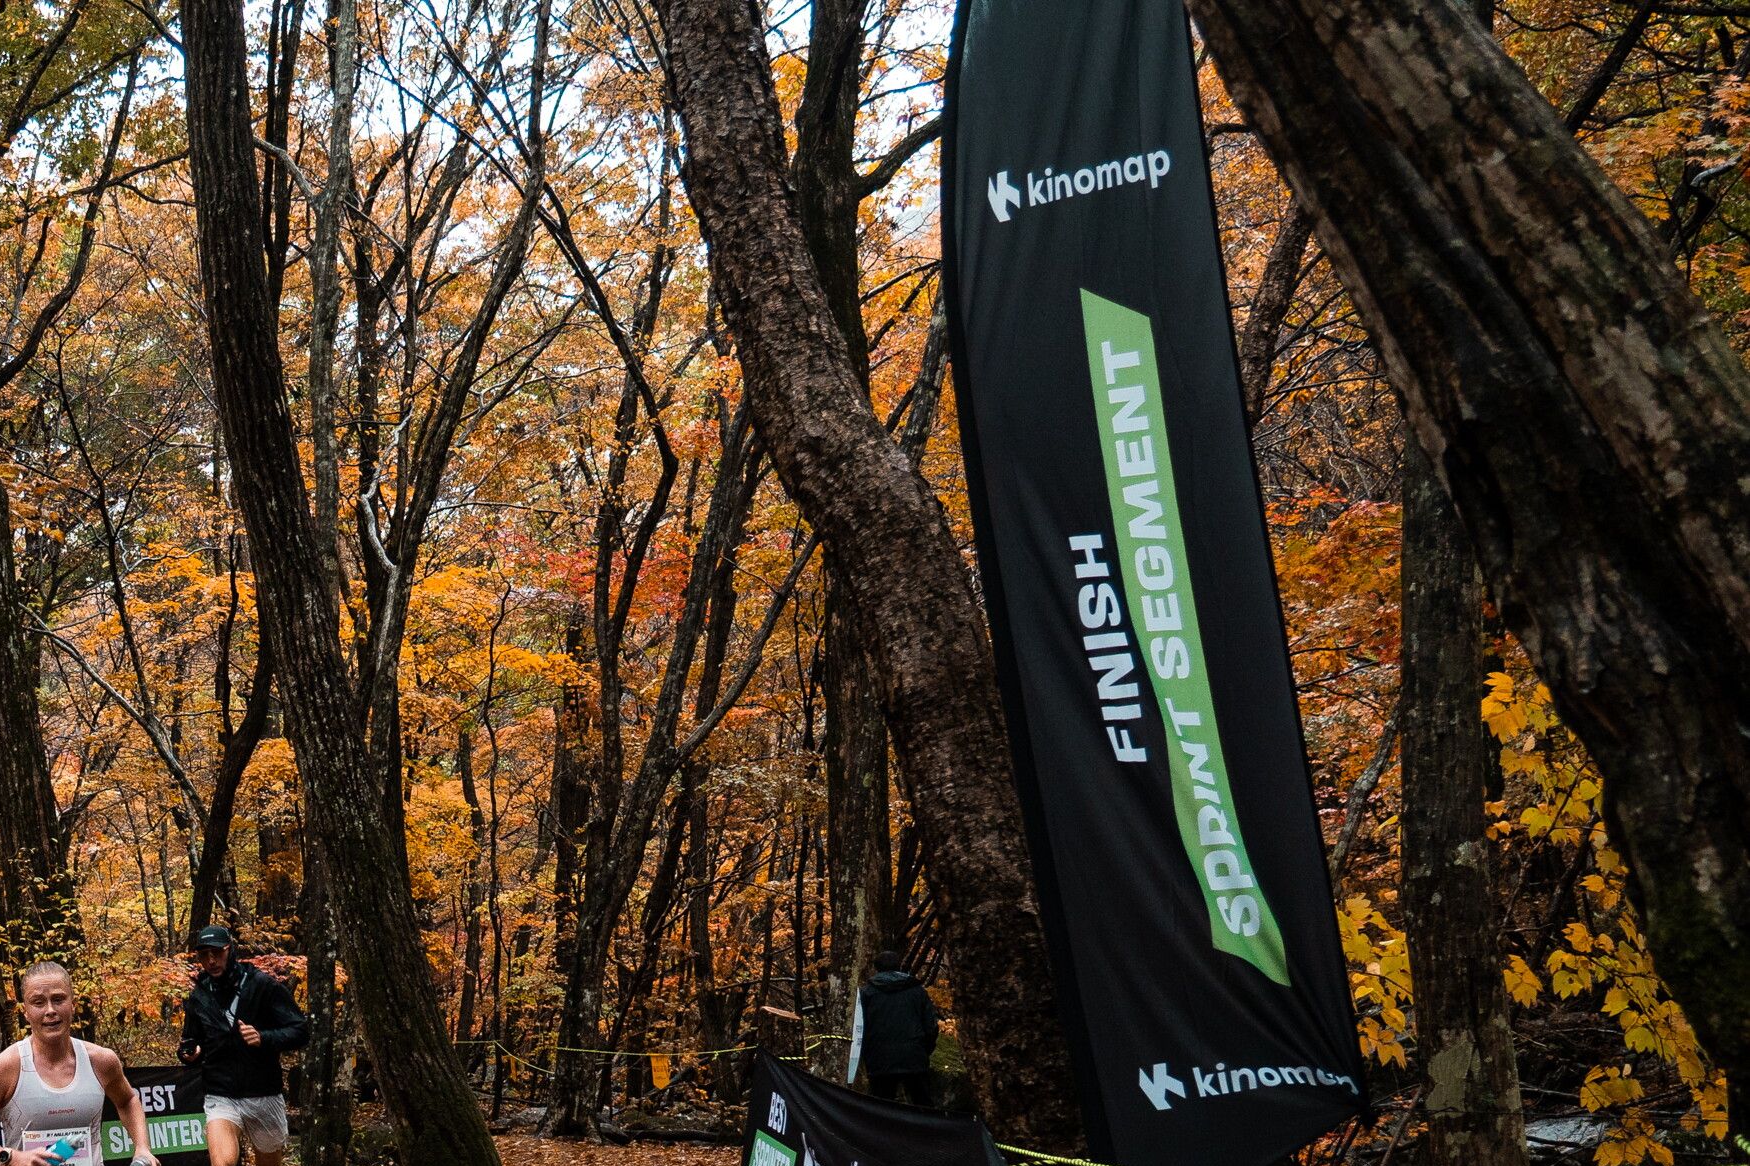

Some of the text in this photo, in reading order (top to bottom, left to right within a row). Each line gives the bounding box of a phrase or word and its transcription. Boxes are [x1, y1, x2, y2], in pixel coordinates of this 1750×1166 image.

[1028, 151, 1170, 206] kinomap
[1068, 534, 1147, 763] FINISH
[1101, 340, 1260, 936] SPRINT SEGMENT
[133, 1085, 176, 1113] EST
[768, 1092, 787, 1135] BEST
[110, 1119, 205, 1154] SPINTER
